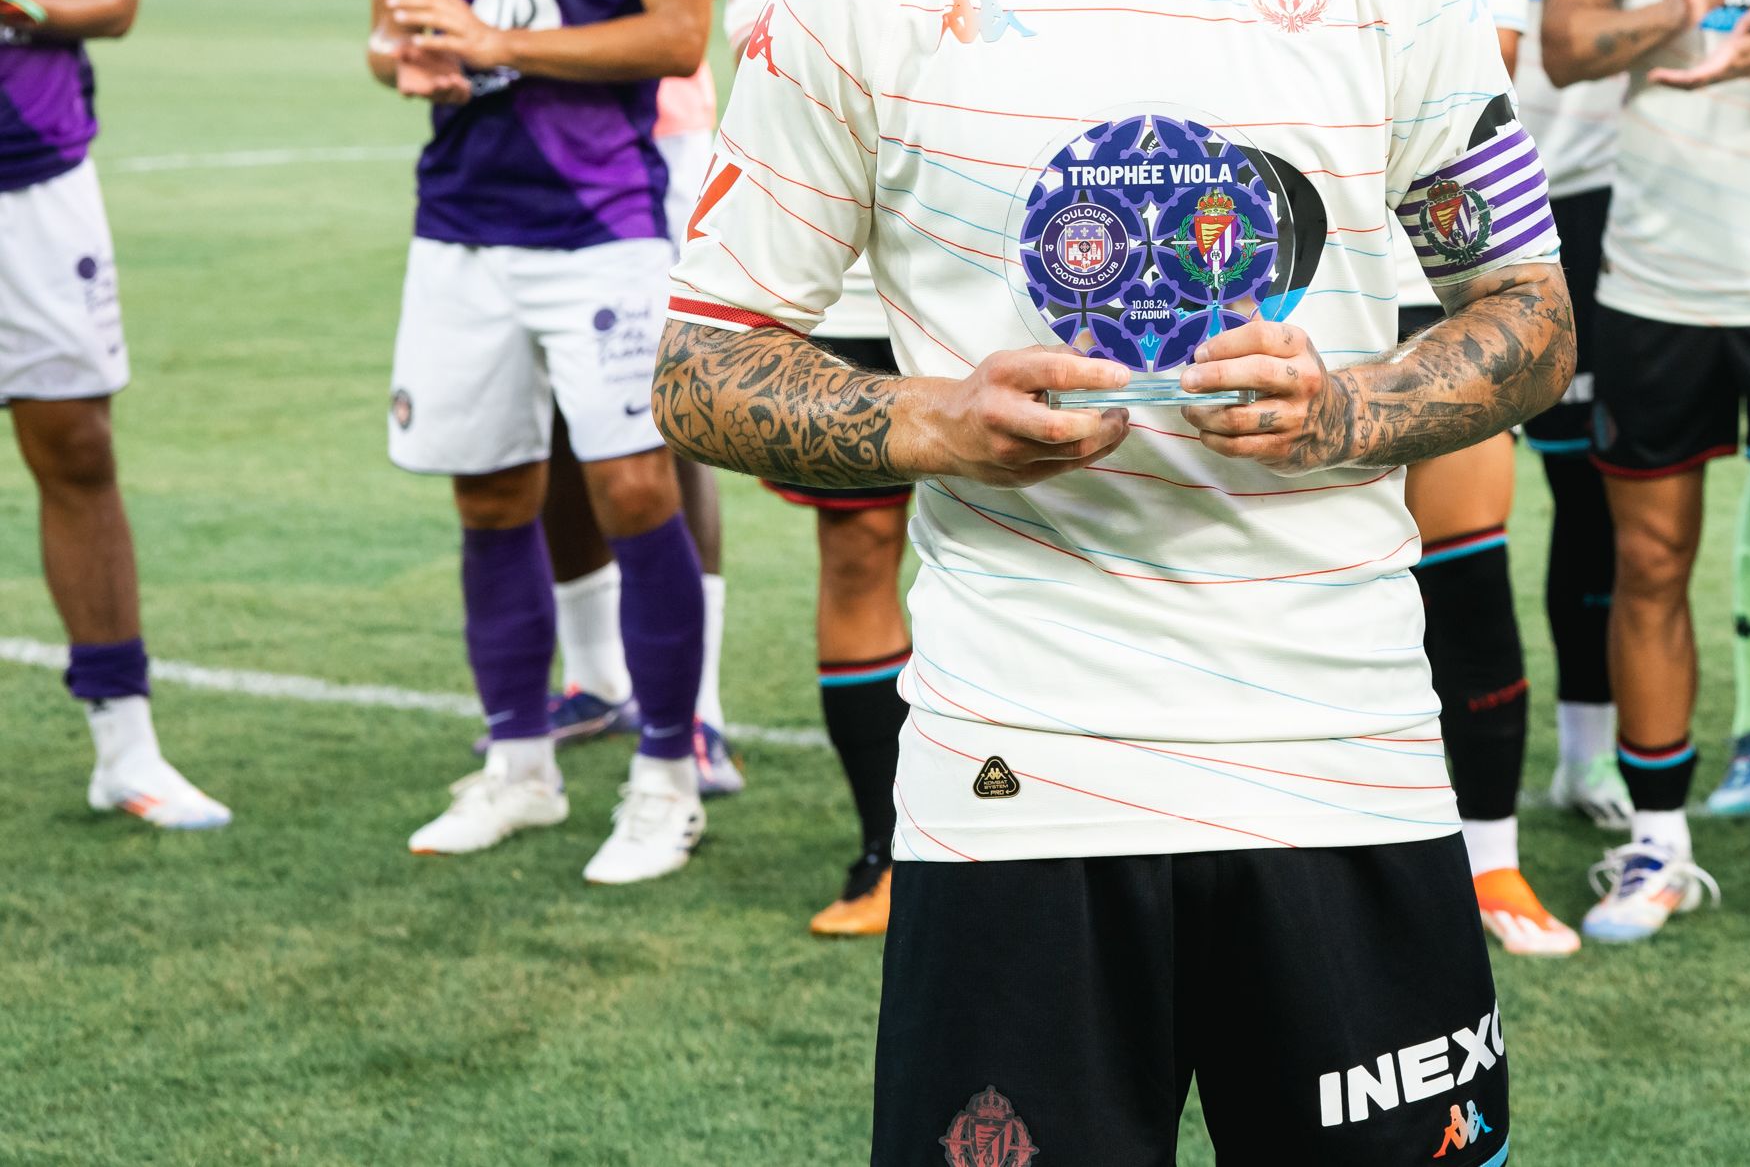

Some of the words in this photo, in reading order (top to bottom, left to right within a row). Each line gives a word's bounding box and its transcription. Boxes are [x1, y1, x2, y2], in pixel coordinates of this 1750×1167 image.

[1067, 160, 1164, 186] TROPHÉE
[1169, 164, 1233, 184] VIOLA
[1055, 208, 1114, 227] TOULOUSE
[1044, 244, 1054, 252] 19
[1114, 242, 1125, 250] 37
[1051, 262, 1097, 286] FOOTBALL
[1097, 261, 1119, 281] CLUB
[1132, 299, 1168, 309] 10.08.24
[1130, 309, 1170, 320] STADIUM
